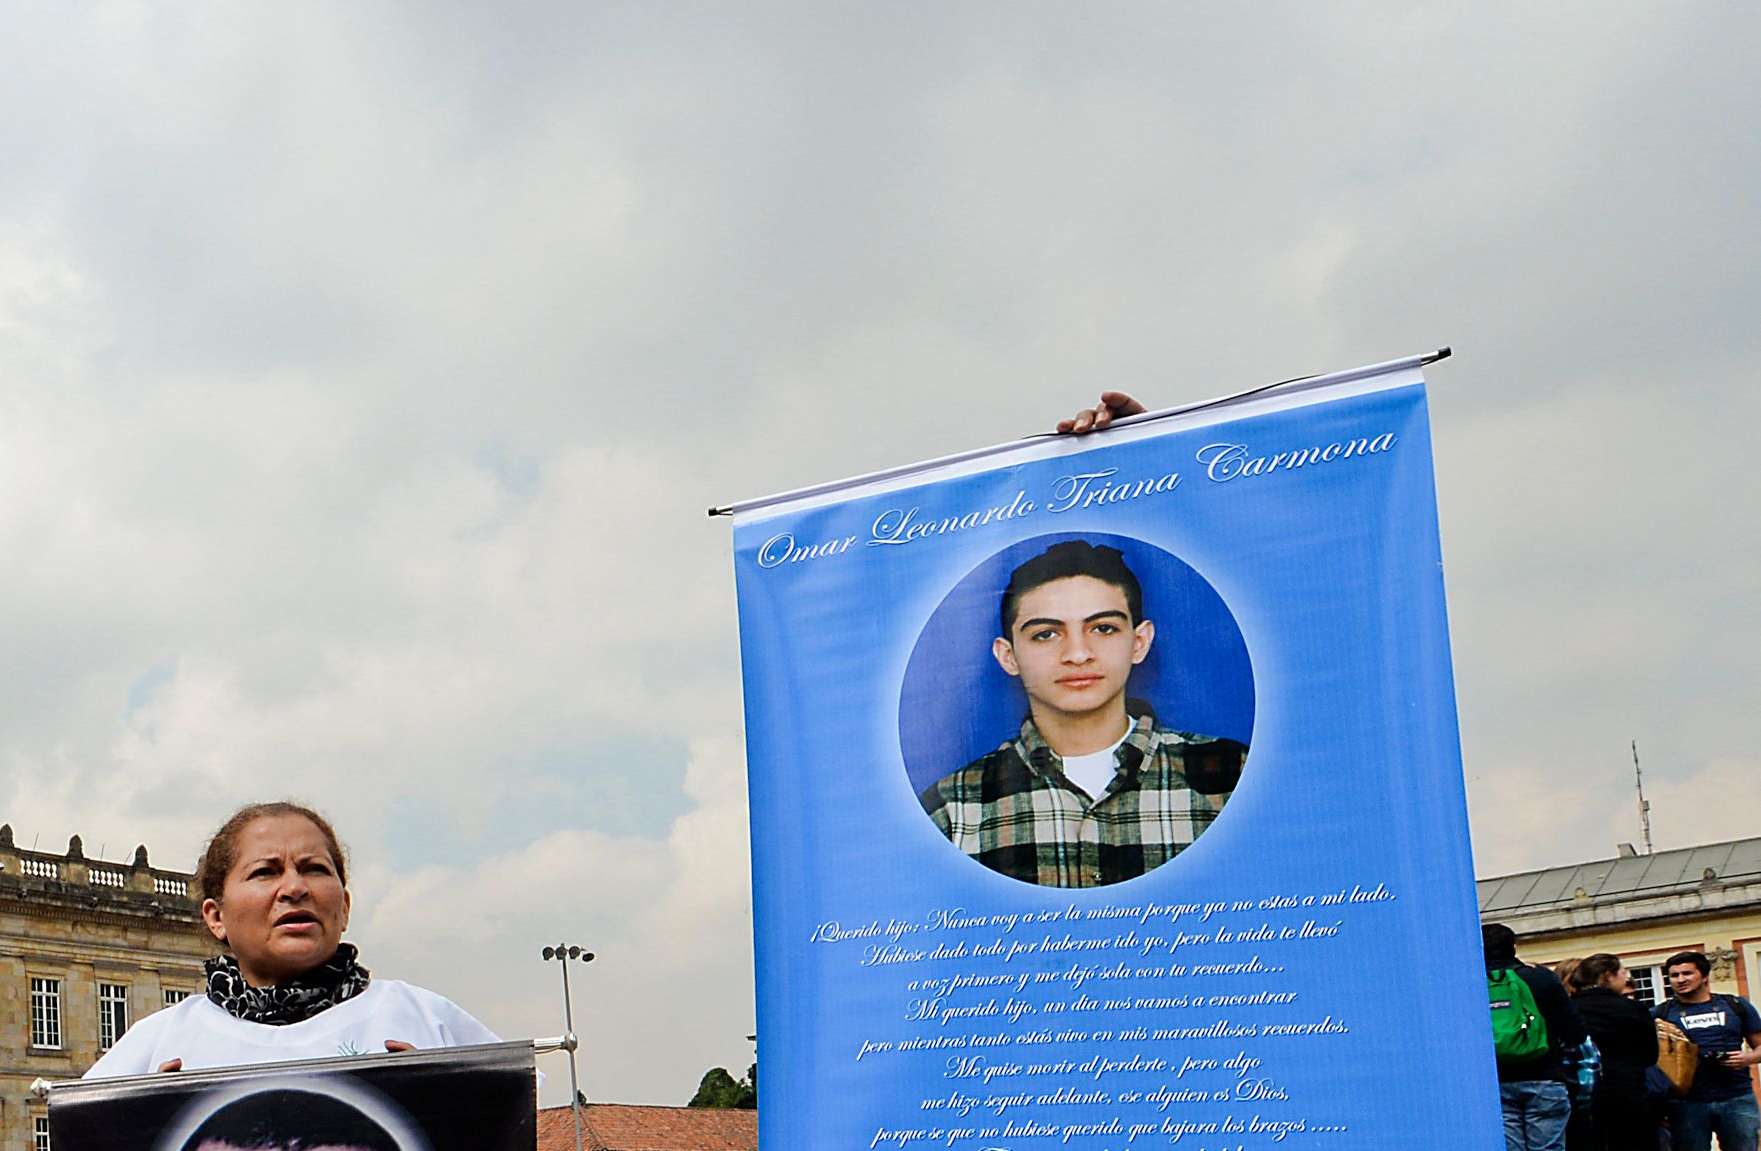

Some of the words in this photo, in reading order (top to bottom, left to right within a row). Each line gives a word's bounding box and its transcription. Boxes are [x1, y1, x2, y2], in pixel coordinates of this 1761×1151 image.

[757, 531, 857, 569] Omar
[865, 489, 1038, 547] Leonardo
[1047, 466, 1183, 514] Triana
[1195, 431, 1399, 483] Carmona
[811, 920, 881, 943] ¡Querido
[924, 907, 988, 931] Nunca
[991, 915, 1017, 933] voy
[1022, 913, 1036, 924] a
[1037, 909, 1062, 923] ser
[1064, 904, 1083, 920] la
[1087, 905, 1141, 920] misma
[1140, 902, 1202, 925] porque
[1202, 903, 1227, 922] ya
[1231, 899, 1254, 912] no
[1258, 894, 1298, 910] estas
[1302, 896, 1316, 907] a
[1320, 891, 1346, 905] mi
[1349, 883, 1397, 904] lado.
[860, 944, 927, 967] Hubiese
[929, 943, 970, 960] dado
[972, 938, 1006, 957] todo
[1005, 941, 1037, 963] por
[1039, 933, 1111, 954] haberme
[1113, 930, 1140, 949] ido
[1139, 935, 1169, 957] yo,
[1169, 931, 1211, 953] pero
[1215, 926, 1234, 944] la
[1237, 923, 1276, 943] vida
[1279, 925, 1296, 940] te
[1299, 919, 1343, 939] llevó
[907, 980, 921, 992] a
[946, 974, 1015, 997] primero
[1014, 973, 1031, 993] y
[1034, 970, 1060, 985] me
[1062, 963, 1099, 990] dejó
[1099, 961, 1132, 980] sola
[1135, 966, 1166, 978] con
[1169, 963, 1188, 978] tu
[1191, 955, 1284, 977] recuerdo...
[904, 998, 940, 1022] Mi
[941, 1002, 999, 1026] querido
[1002, 997, 1037, 1024] hijo,
[1043, 1001, 1069, 1014] un
[1103, 996, 1132, 1010] nos
[1134, 993, 1189, 1009] vamos
[1192, 996, 1206, 1008] a
[1208, 990, 1298, 1008] encontrar
[856, 1039, 893, 1061] pero
[897, 1034, 967, 1052] mientras
[969, 1032, 1011, 1048] tanto
[1015, 1028, 1053, 1045] estás
[1056, 1029, 1088, 1043] vivo
[1092, 1029, 1114, 1041] en
[1118, 1026, 1147, 1042] mis
[1152, 1019, 1257, 1041] maravillosos
[1261, 1016, 1349, 1036] recuerdos.
[943, 1055, 986, 1080] Me
[983, 1061, 1023, 1085] quise
[1026, 1059, 1077, 1076] morir
[1079, 1054, 1100, 1073] al
[1177, 1056, 1218, 1078] pero
[1223, 1051, 1263, 1078] algo
[920, 1097, 945, 1111] me
[947, 1091, 981, 1118] hizo
[984, 1092, 1037, 1116] seguir
[1037, 1087, 1112, 1105] adelante,
[1118, 1092, 1143, 1104] ese
[1145, 1085, 1209, 1112] alguien
[1213, 1089, 1230, 1101] es
[1234, 1078, 1290, 1101] Dios,
[870, 1127, 927, 1149] porque
[928, 1128, 944, 1140] se
[947, 1127, 975, 1146] que
[978, 1127, 999, 1139] no
[1002, 1120, 1059, 1138] hubiese
[1062, 1117, 1124, 1144] querido
[1128, 1123, 1158, 1143] que
[1160, 1117, 1218, 1144] bajara
[1221, 1115, 1246, 1133] los
[1249, 1115, 1306, 1143] brazos
